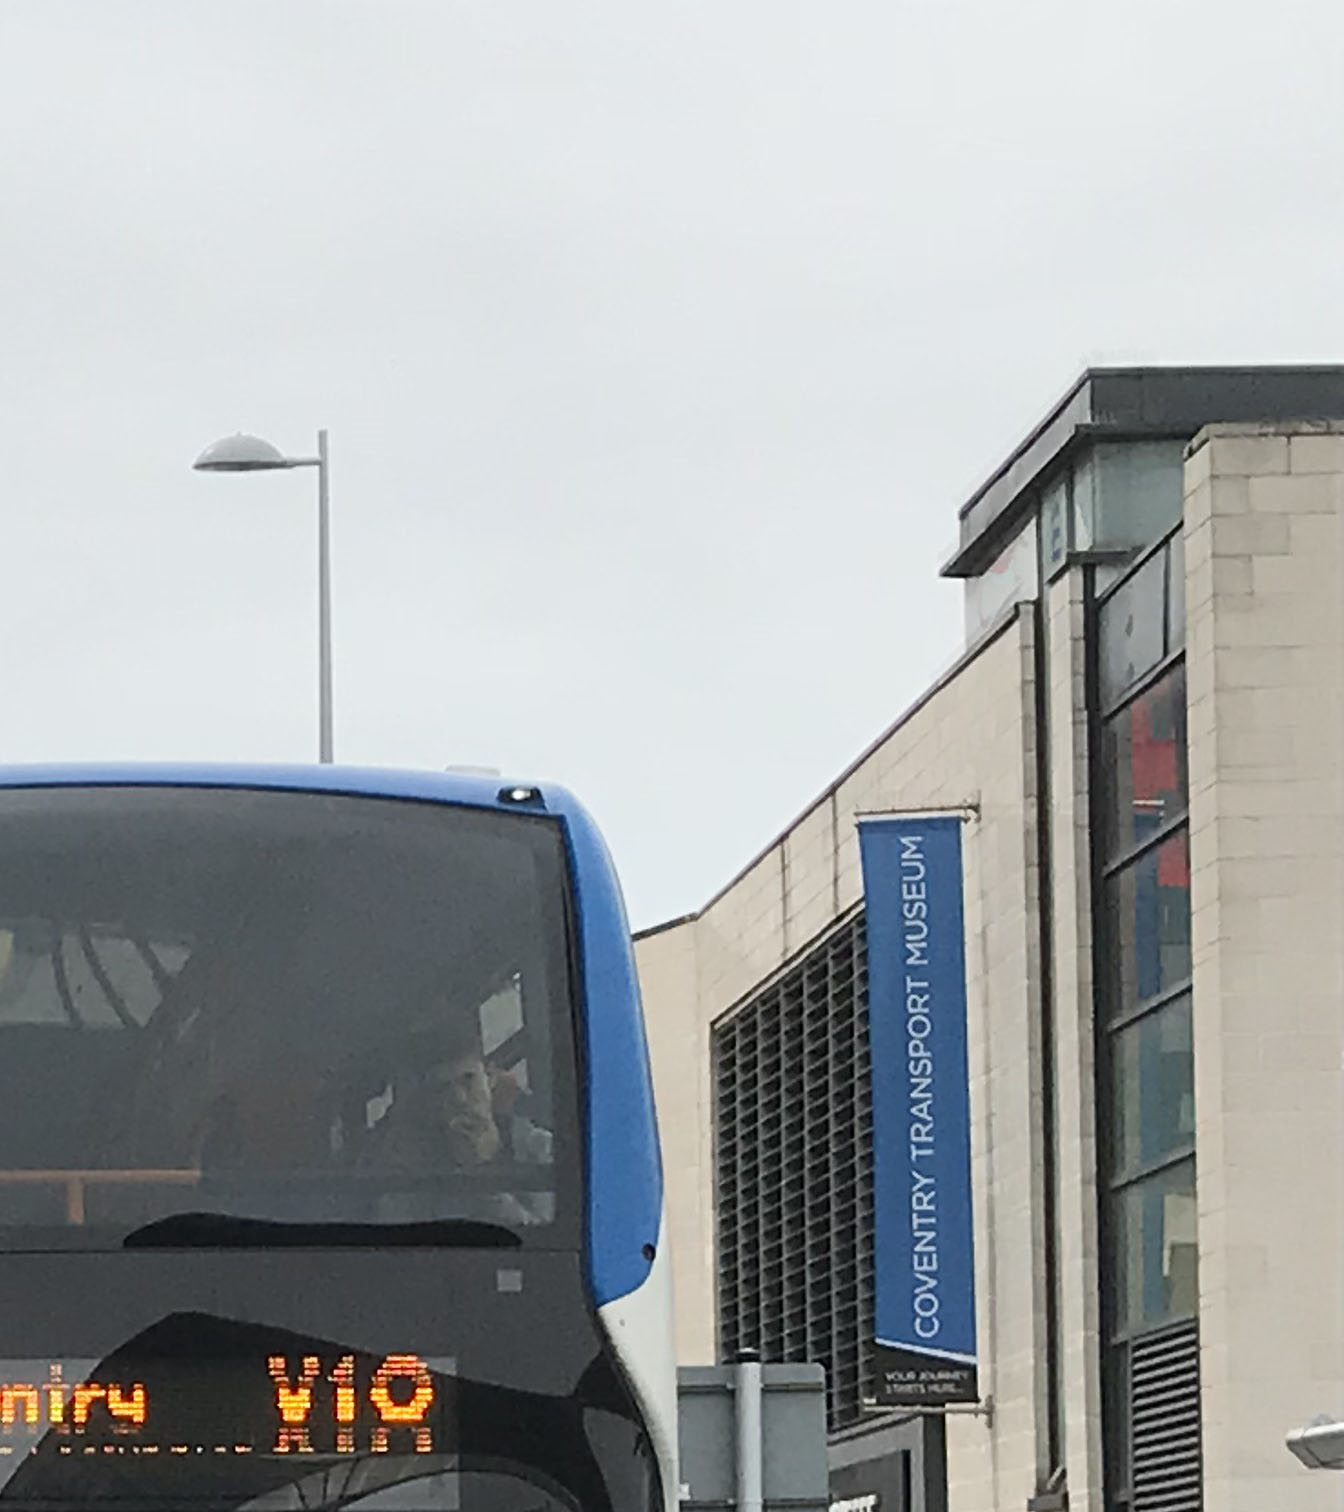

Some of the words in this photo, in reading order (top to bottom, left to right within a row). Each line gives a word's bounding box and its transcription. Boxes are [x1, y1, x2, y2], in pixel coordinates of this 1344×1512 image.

[900, 836, 928, 965] MUSEUM
[906, 976, 934, 1161] TRANSPORT
[912, 1171, 939, 1339] COVENTRY
